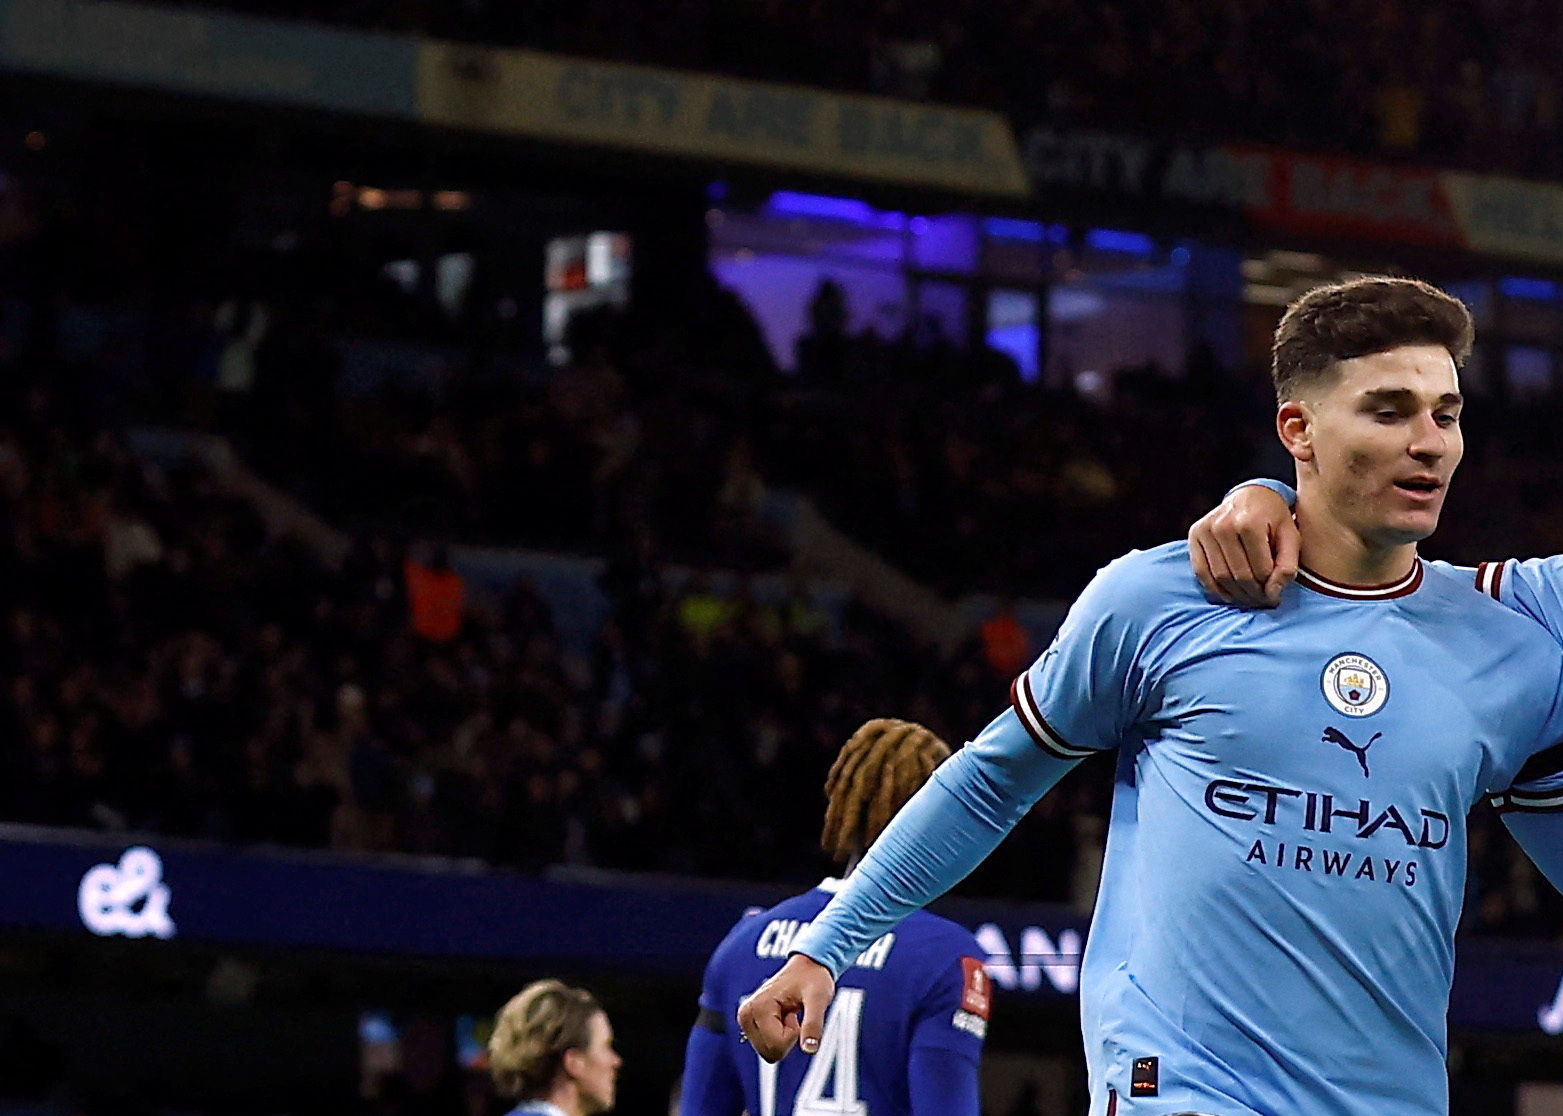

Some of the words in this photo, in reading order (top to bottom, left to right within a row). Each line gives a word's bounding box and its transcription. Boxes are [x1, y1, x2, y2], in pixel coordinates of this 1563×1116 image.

[1329, 658, 1382, 681] MANCHESTER
[1344, 706, 1364, 714] CITY
[1204, 779, 1450, 850] ETIHAD
[1246, 839, 1418, 886] AIRWAYS
